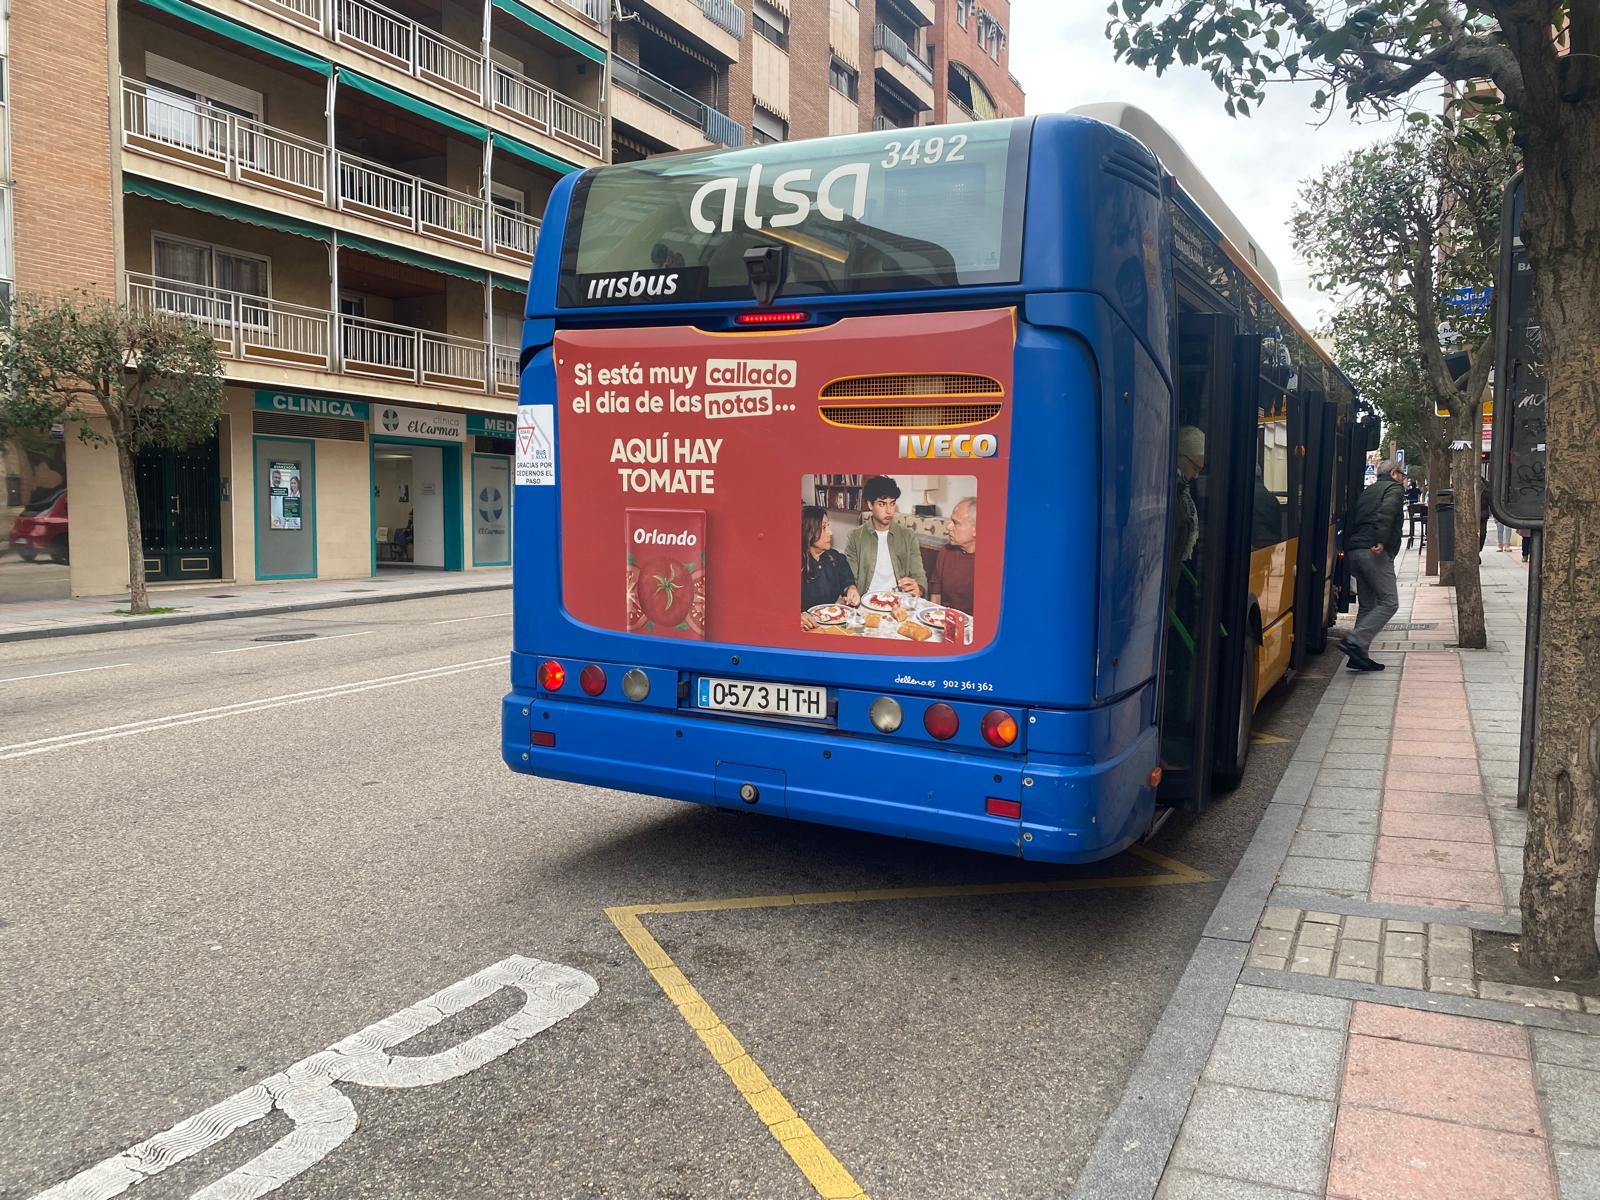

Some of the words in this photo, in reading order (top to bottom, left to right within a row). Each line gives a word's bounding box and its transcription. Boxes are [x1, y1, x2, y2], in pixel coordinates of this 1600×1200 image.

[881, 134, 968, 168] 3492
[690, 162, 870, 233] alsa
[587, 270, 679, 299] irisbus
[574, 363, 593, 386] Si
[598, 361, 644, 385] está
[650, 366, 697, 389] muy
[709, 362, 792, 384] callado
[272, 395, 355, 416] CLINICA
[572, 390, 591, 413] el
[596, 391, 630, 413] día
[635, 390, 663, 413] de
[669, 389, 702, 413] las
[408, 420, 419, 433] El
[420, 422, 459, 437] Carmen
[484, 418, 515, 432] MED
[610, 432, 669, 464] AQUÍ
[674, 438, 723, 463] HAY
[900, 434, 998, 458] IVECO
[618, 468, 715, 494] TOMATE
[633, 528, 697, 546] Orlando
[713, 683, 770, 709] 0573
[776, 688, 820, 714] HTH
[943, 680, 959, 689] 902
[961, 681, 976, 691] 361
[977, 682, 993, 692] 362
